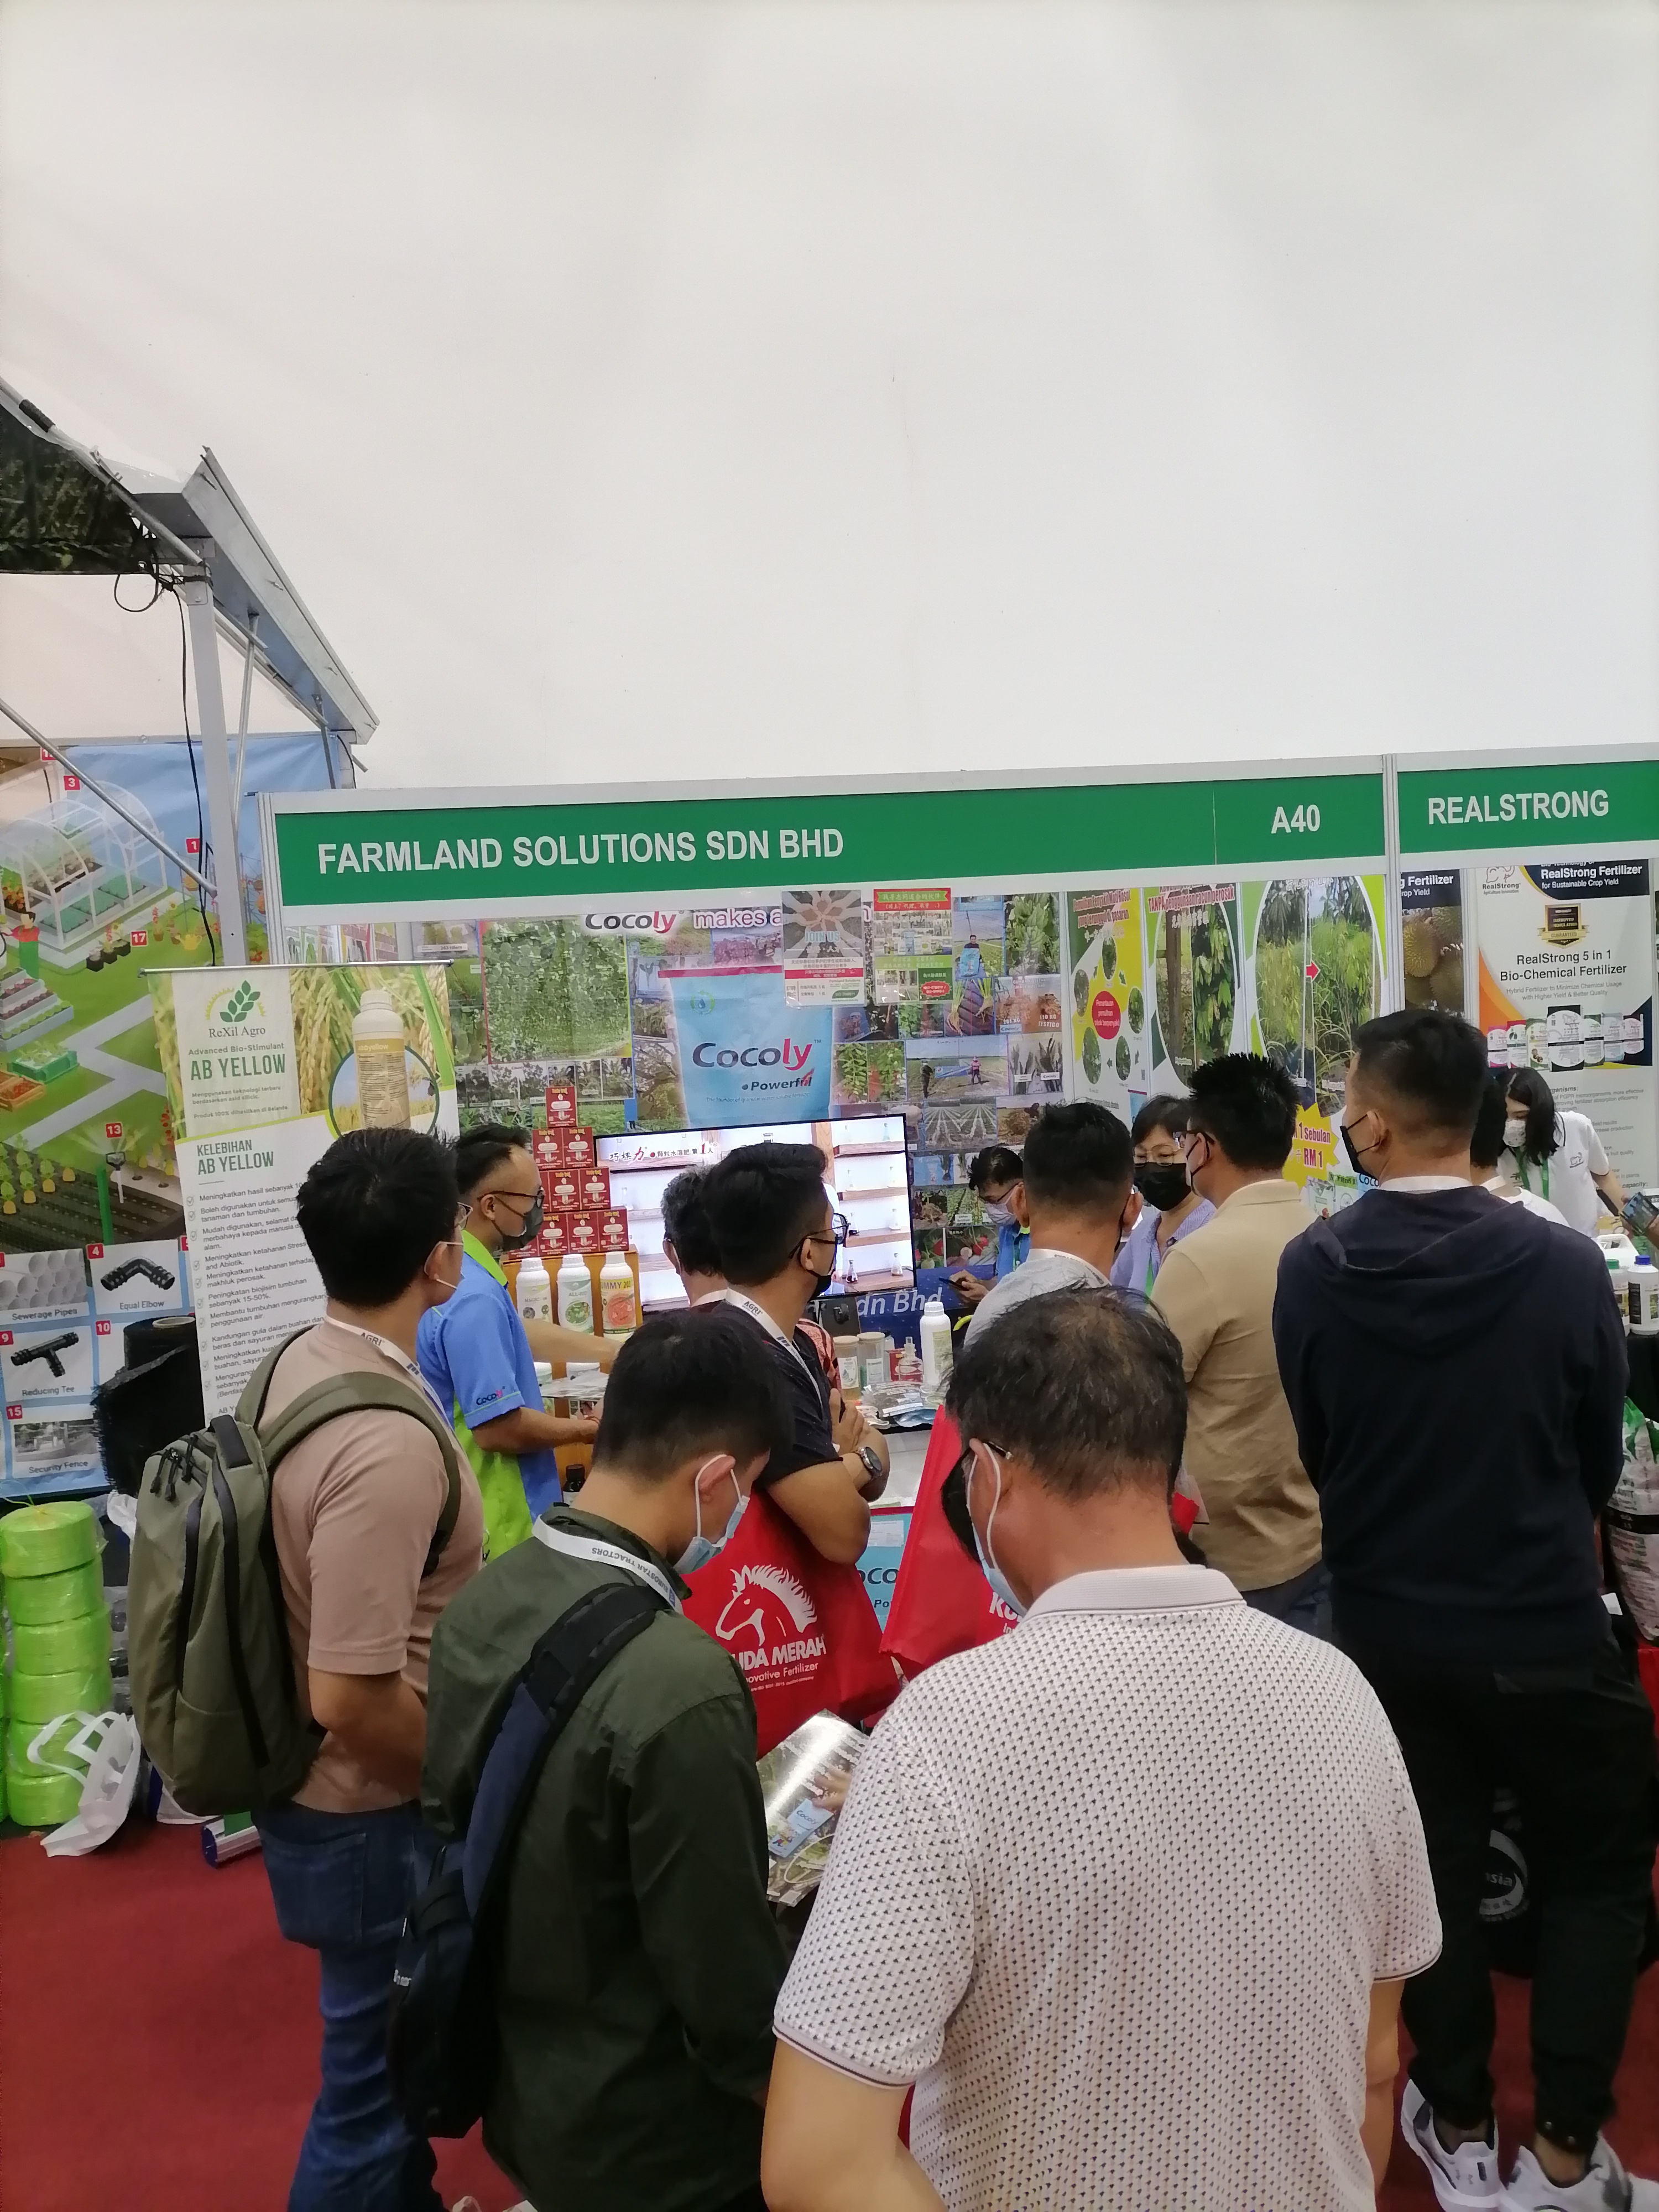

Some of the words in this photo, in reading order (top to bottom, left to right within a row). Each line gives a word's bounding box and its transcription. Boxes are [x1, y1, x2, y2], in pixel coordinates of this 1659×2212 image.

[69, 778, 75, 787] 3
[1428, 790, 1610, 825] REALSTRONG
[1271, 805, 1321, 834] A40
[191, 841, 197, 849] 1
[319, 838, 503, 874] FARMLAND
[513, 832, 696, 867] SOLUTIONS
[706, 830, 769, 862] SDN
[780, 828, 843, 859] BHD
[1541, 868, 1596, 879] RealStrong
[1599, 866, 1642, 875] Fertilizer
[1408, 875, 1453, 886] Fertilizer
[1552, 880, 1587, 888] Sustainable
[1148, 896, 1165, 912] TANPA
[1196, 890, 1211, 905] racun
[1212, 886, 1234, 903] perosak
[585, 911, 677, 933] Cocoly
[694, 909, 766, 928] makes
[133, 932, 146, 943] 17
[805, 931, 826, 942] JOIN
[827, 930, 840, 942] US
[1517, 953, 1579, 965] RealStrong
[1583, 951, 1589, 961] 5
[1593, 950, 1602, 960] in
[1606, 949, 1611, 959] 1
[1500, 967, 1575, 981] Bio-Chemical
[1580, 964, 1626, 976] Fertilizer
[241, 1026, 266, 1037] Agro
[189, 1047, 228, 1055] Advanced
[231, 1043, 284, 1052] Bio-Stimulant
[692, 1038, 812, 1071] Cocoly
[191, 1060, 212, 1080] AB
[218, 1054, 285, 1078] YELLOW
[107, 1125, 122, 1135] 13
[1304, 1127, 1331, 1144] Sebulan
[197, 1139, 252, 1156] KELEBIHAN
[198, 1158, 215, 1175] AB
[218, 1151, 274, 1172] YELLOW
[1303, 1147, 1316, 1167] RM
[1318, 1150, 1323, 1168] 1
[1359, 1173, 1379, 1187] Coco
[200, 1191, 246, 1201] Meningkatkan
[265, 1183, 294, 1193] sebanyak
[221, 1202, 257, 1212] digunakan
[201, 1214, 230, 1223] tanaman
[247, 1207, 281, 1216] tumbuhan.
[265, 1217, 289, 1225] selamat
[203, 1232, 241, 1243] merbahaya
[242, 1229, 267, 1238] kepada
[269, 1225, 294, 1233] manusia
[92, 1246, 99, 1255] 4
[205, 1251, 252, 1262] Meningkatkan
[253, 1245, 286, 1255] ketahanan
[206, 1269, 253, 1280] Meningkatkan
[255, 1262, 288, 1272] ketahanan
[207, 1279, 235, 1288] makhluk
[208, 1289, 250, 1300] Peningkatan
[278, 1278, 307, 1287] tumbuhan
[119, 1302, 139, 1310] Equal
[208, 1298, 241, 1309] sebanyak
[210, 1309, 246, 1319] Membantu
[247, 1303, 280, 1312] tumbuhan
[281, 1293, 326, 1307] mengurangkan
[744, 1301, 761, 1315] AGRI
[857, 1296, 885, 1316] dn
[893, 1287, 942, 1313] Bhd
[12, 1311, 52, 1321] Sewerage
[54, 1308, 77, 1318] Pipes
[97, 1323, 110, 1332] 10
[211, 1317, 253, 1328] penggunaan
[2, 1333, 9, 1342] 9
[212, 1332, 251, 1342] Kandungan
[289, 1319, 311, 1328] buahan
[248, 1335, 275, 1344] sayuran
[361, 1332, 383, 1347] AGRI
[213, 1349, 260, 1361] Meningkatkan
[22, 1388, 59, 1396] Reducing
[8, 1407, 22, 1417] 15
[29, 1465, 61, 1474] Security
[592, 1547, 635, 1566] TRACTORS
[731, 1648, 769, 1671] UDA
[771, 1637, 827, 1666] MERAH
[746, 1671, 780, 1683] ovative
[784, 1663, 818, 1677] Fertilizer
[796, 1809, 818, 1825] Cocoly
